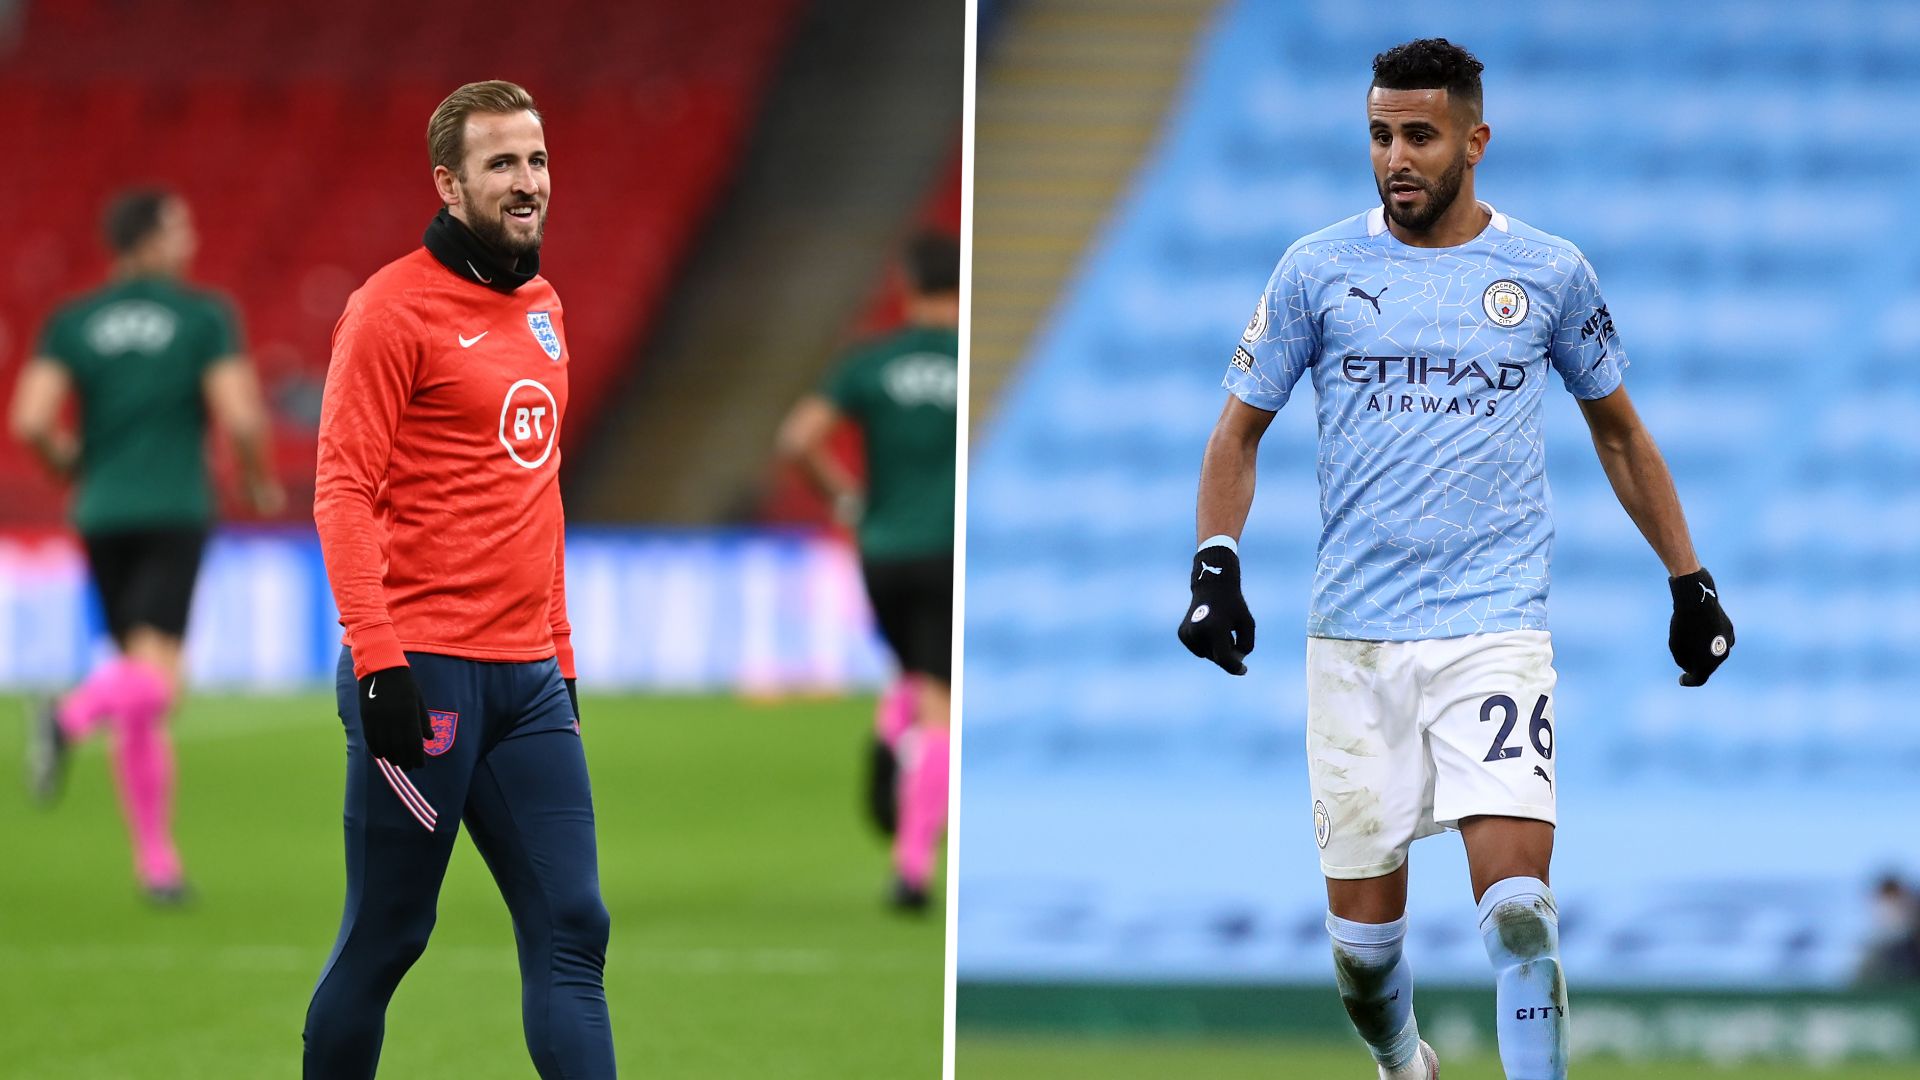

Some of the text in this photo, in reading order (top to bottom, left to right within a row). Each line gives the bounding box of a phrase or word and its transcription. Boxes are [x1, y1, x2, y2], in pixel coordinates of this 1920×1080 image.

[1488, 283, 1525, 300] MANCHESTER
[1343, 355, 1526, 391] ETIHAD
[1367, 394, 1498, 416] AIRWAYS
[513, 406, 546, 441] BT
[1479, 693, 1553, 763] 26
[1516, 1005, 1564, 1021] CITY
